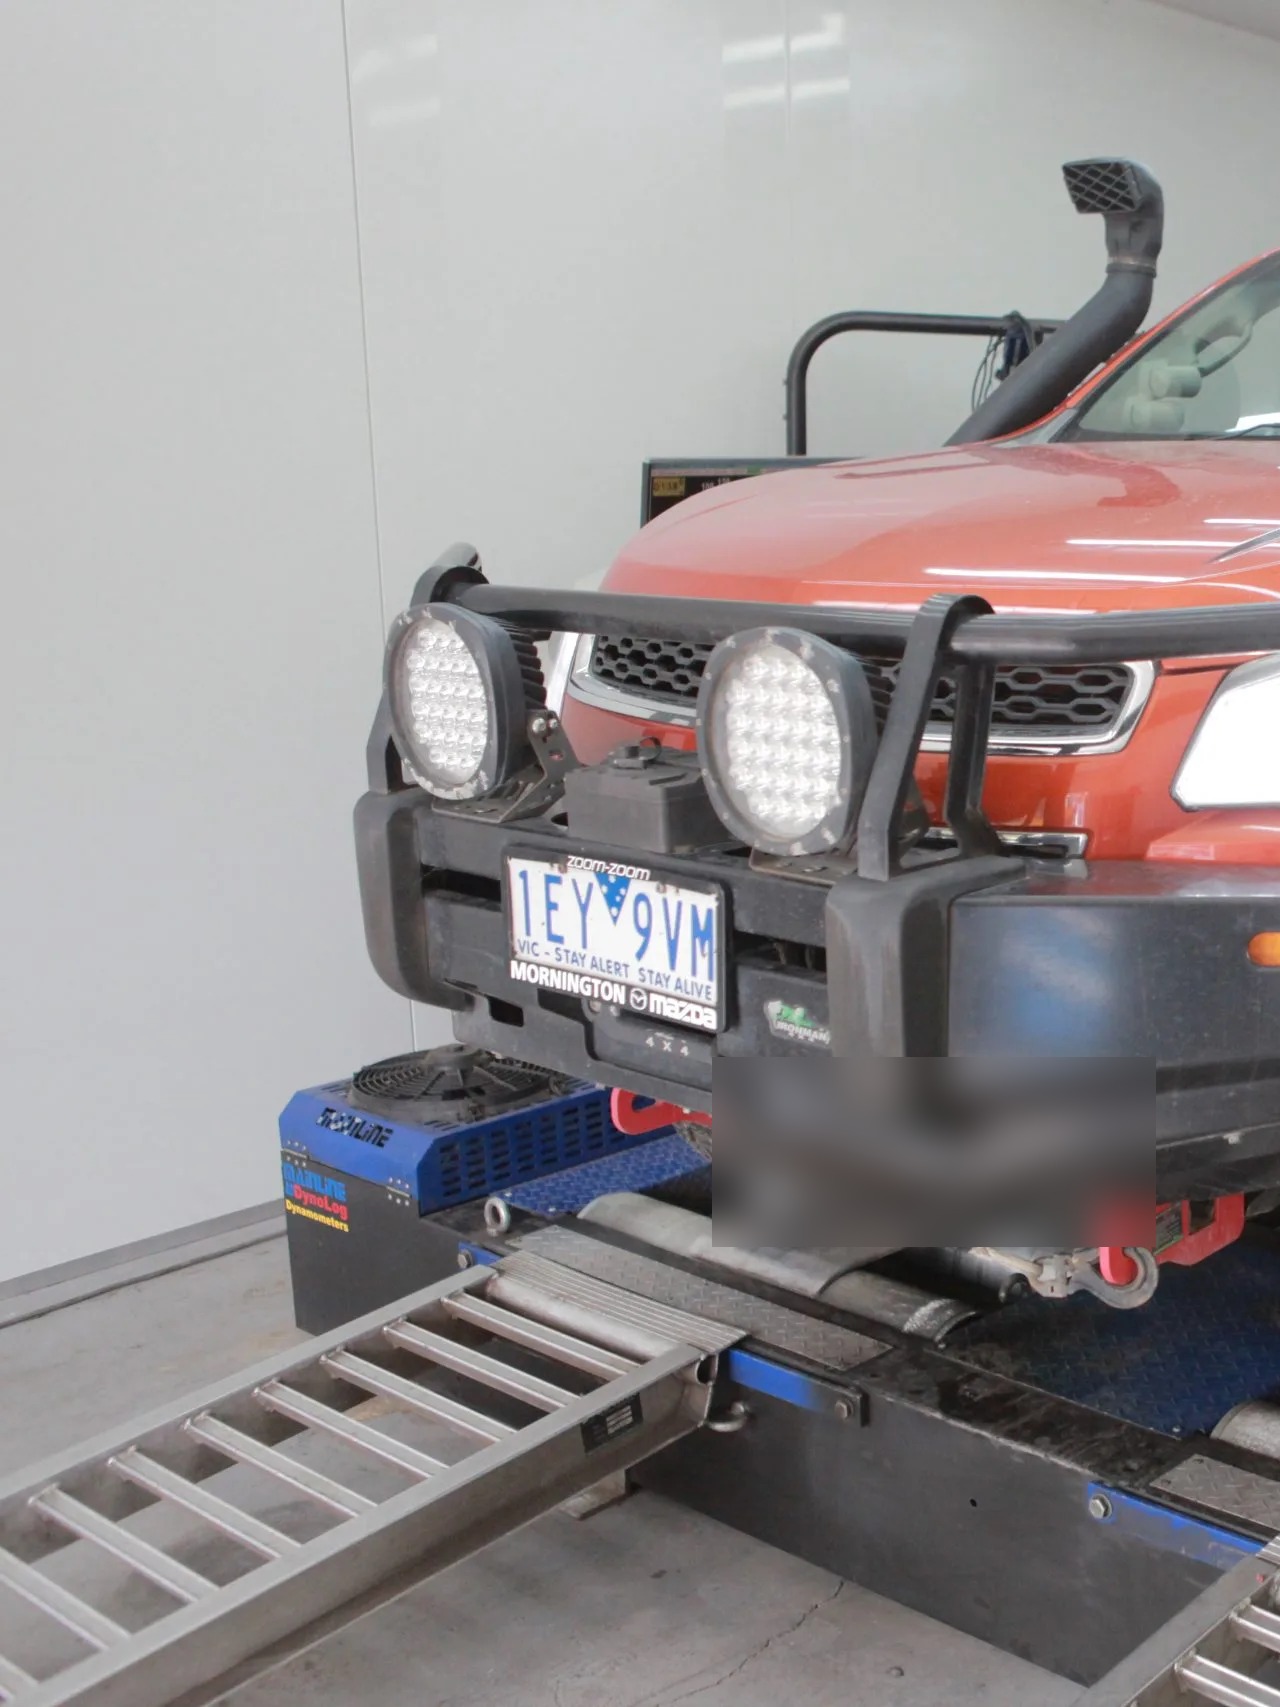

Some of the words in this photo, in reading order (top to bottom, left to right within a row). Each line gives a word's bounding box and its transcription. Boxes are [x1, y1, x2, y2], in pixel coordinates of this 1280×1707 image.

[567, 855, 651, 881] zoom-zoom
[518, 870, 594, 950] 1EY
[632, 892, 714, 982] 9VM
[510, 960, 626, 1005] MORNINGTON
[517, 939, 540, 958] VIC
[555, 947, 586, 967] STAY
[590, 956, 630, 979] ALERT
[638, 967, 671, 989] STAY
[674, 980, 713, 1001] ALIVE
[284, 1198, 350, 1233] Dynamometers
[292, 1183, 349, 1221] DynoLog
